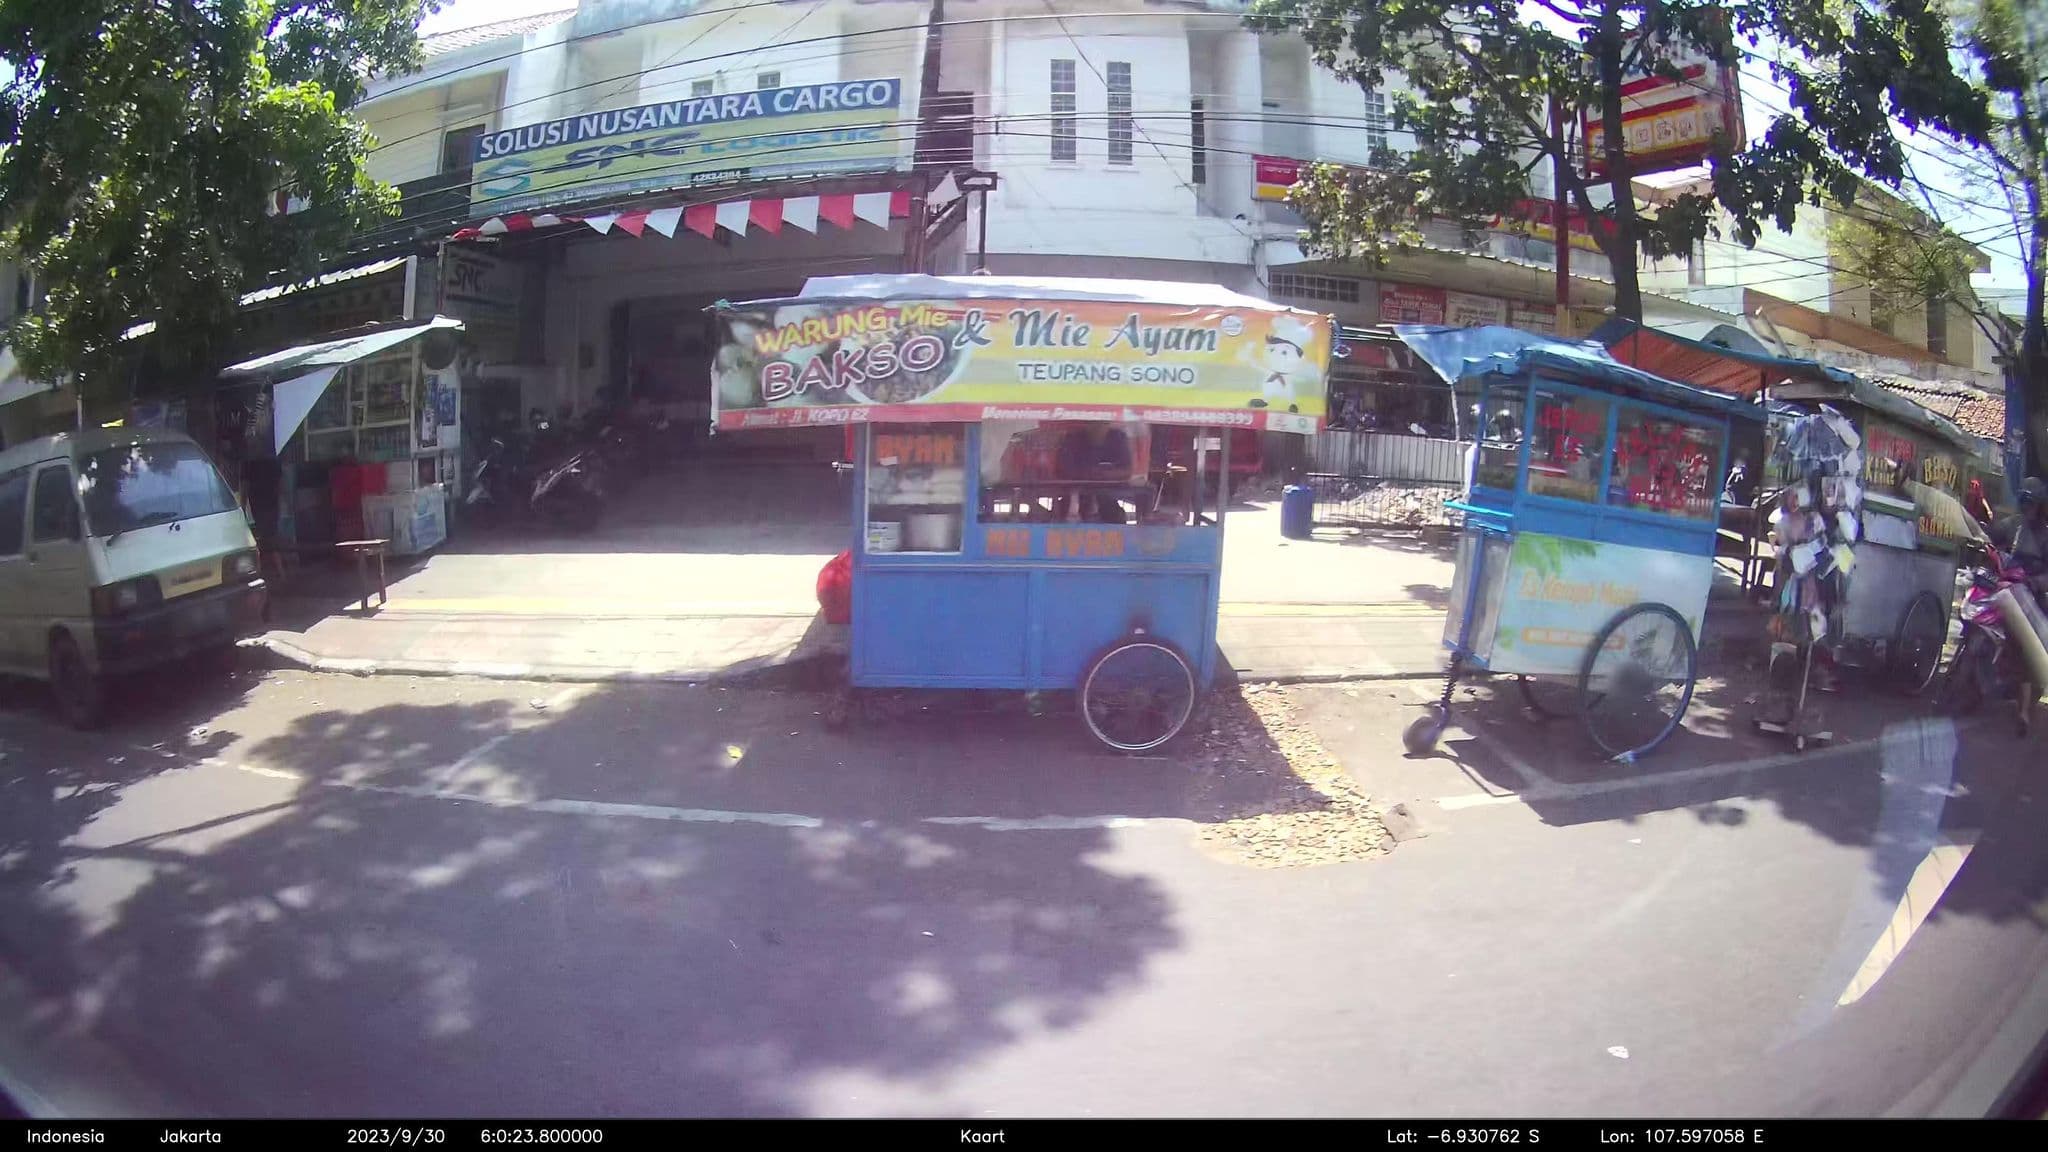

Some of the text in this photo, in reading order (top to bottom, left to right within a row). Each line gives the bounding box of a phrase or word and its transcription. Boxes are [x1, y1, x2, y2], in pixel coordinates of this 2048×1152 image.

[480, 80, 893, 158] SOLUSI NUSANTARA CARGO
[755, 303, 950, 353] WARUNG Mie
[952, 307, 993, 349] &
[1009, 310, 1091, 348] Mie
[1103, 312, 1218, 356] Ayam
[761, 335, 945, 401] BAKSO
[1018, 362, 1196, 385] TEUPANG SONO
